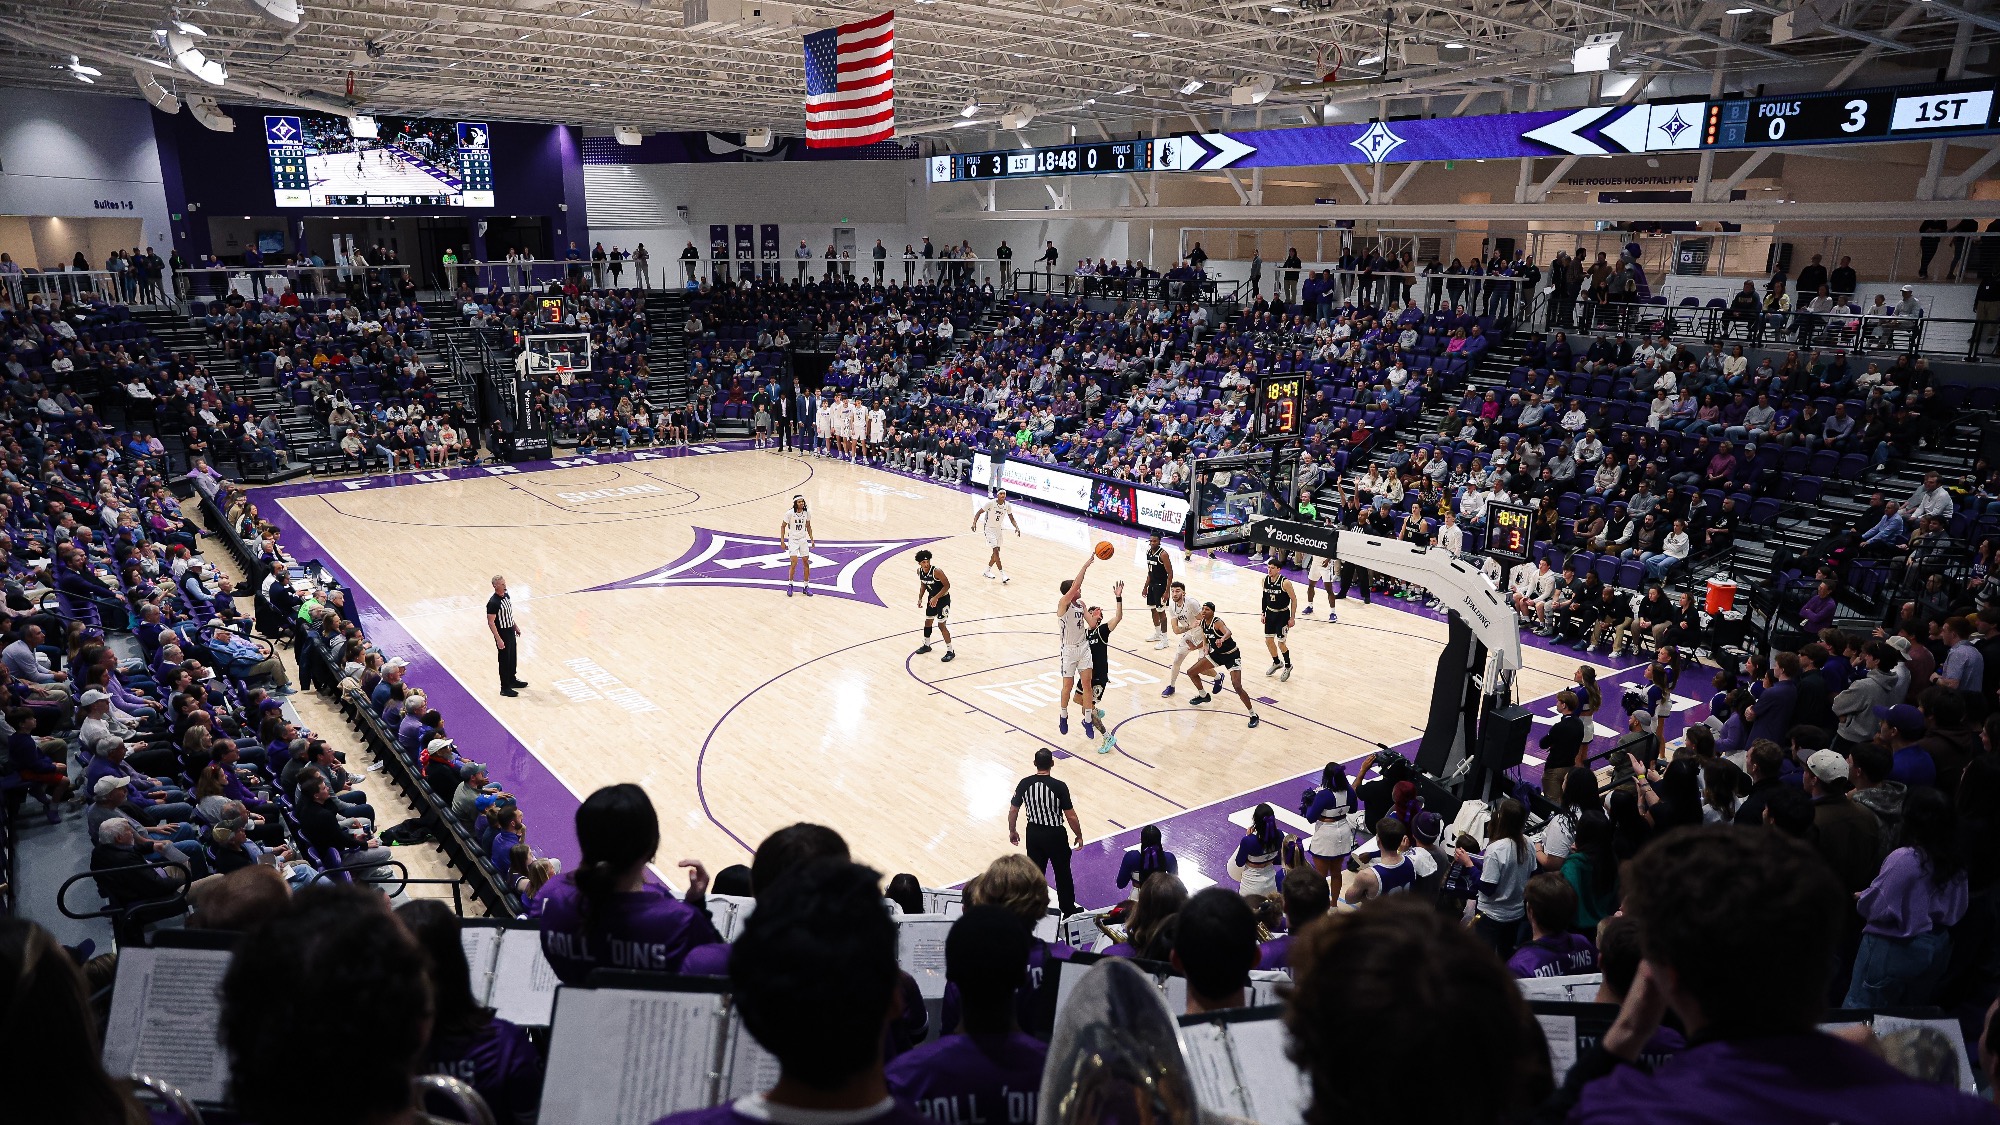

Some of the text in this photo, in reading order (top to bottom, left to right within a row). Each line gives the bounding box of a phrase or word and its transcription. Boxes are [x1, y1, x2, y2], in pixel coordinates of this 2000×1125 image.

[1758, 102, 1801, 118] FOULS
[1840, 100, 1868, 133] 3
[1915, 98, 1968, 123] 1ST
[1768, 117, 1786, 140] 0
[1112, 145, 1131, 155] FOULS
[1372, 134, 1384, 151] F
[966, 157, 980, 165] FOULS
[992, 156, 1001, 174] 3
[1014, 158, 1029, 170] 1ST
[1037, 150, 1077, 172] 18:48
[1087, 148, 1097, 169] 0
[1117, 155, 1125, 169] 0
[970, 165, 977, 177] 0
[1568, 178, 1584, 186] THE
[1586, 177, 1622, 186] ROGUES
[1624, 176, 1683, 185] HOSPITALITY
[94, 200, 119, 210] Suites
[416, 196, 421, 204] 0
[542, 299, 561, 307] 18:47
[551, 308, 560, 321] 3
[1268, 381, 1299, 400] 18:47
[1281, 401, 1293, 430] 3
[1498, 511, 1528, 529] 18:47
[1276, 530, 1328, 550] Bon Secours
[1510, 530, 1521, 549] 3
[1463, 595, 1491, 630] SPALDING
